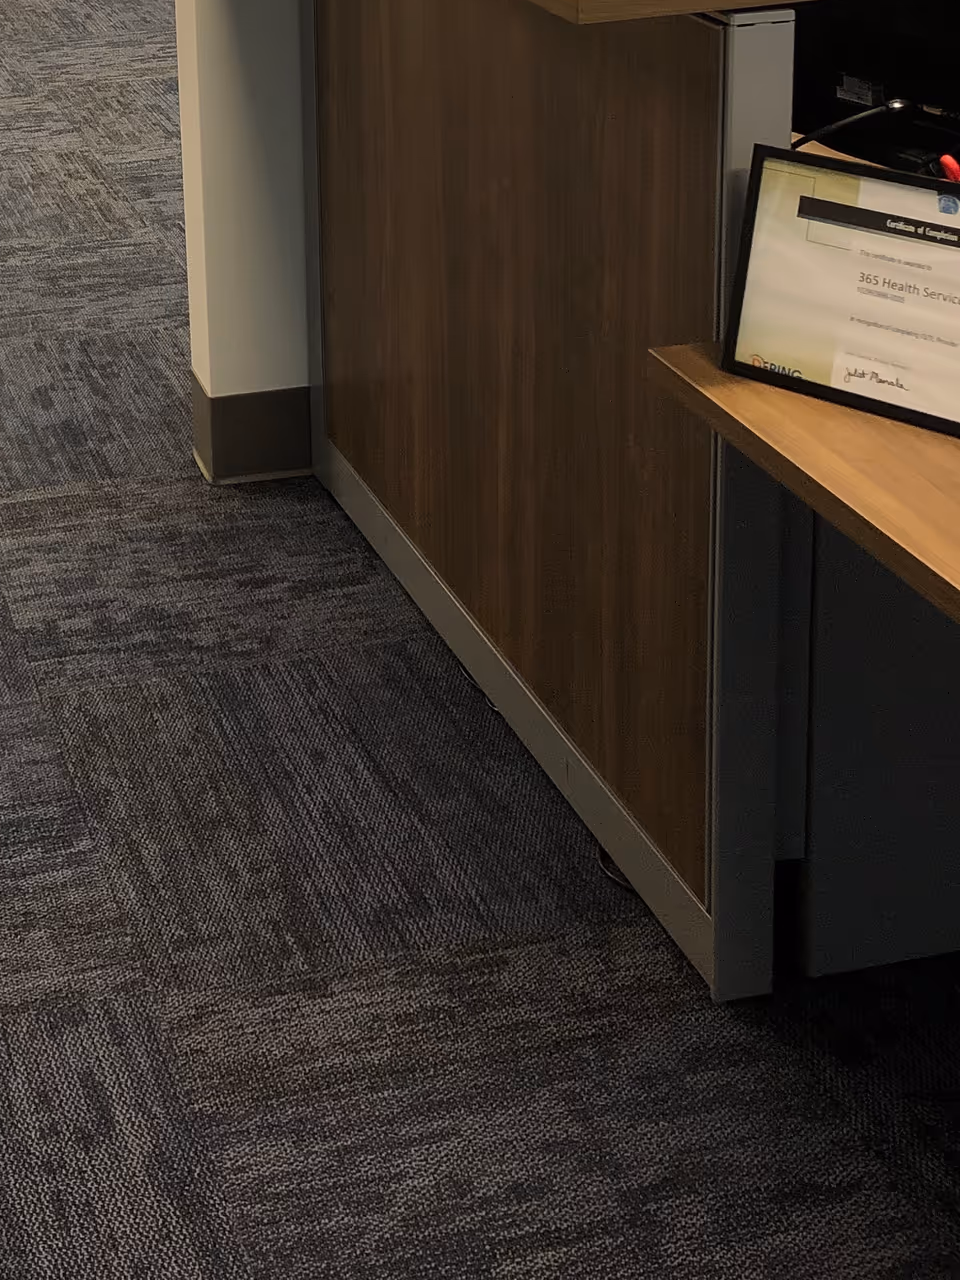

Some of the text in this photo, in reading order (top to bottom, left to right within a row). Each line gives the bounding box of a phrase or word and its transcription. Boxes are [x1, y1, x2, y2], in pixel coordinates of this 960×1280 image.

[886, 219, 959, 241] Certificate of Completion
[858, 271, 879, 286] 365
[882, 277, 920, 296] Health
